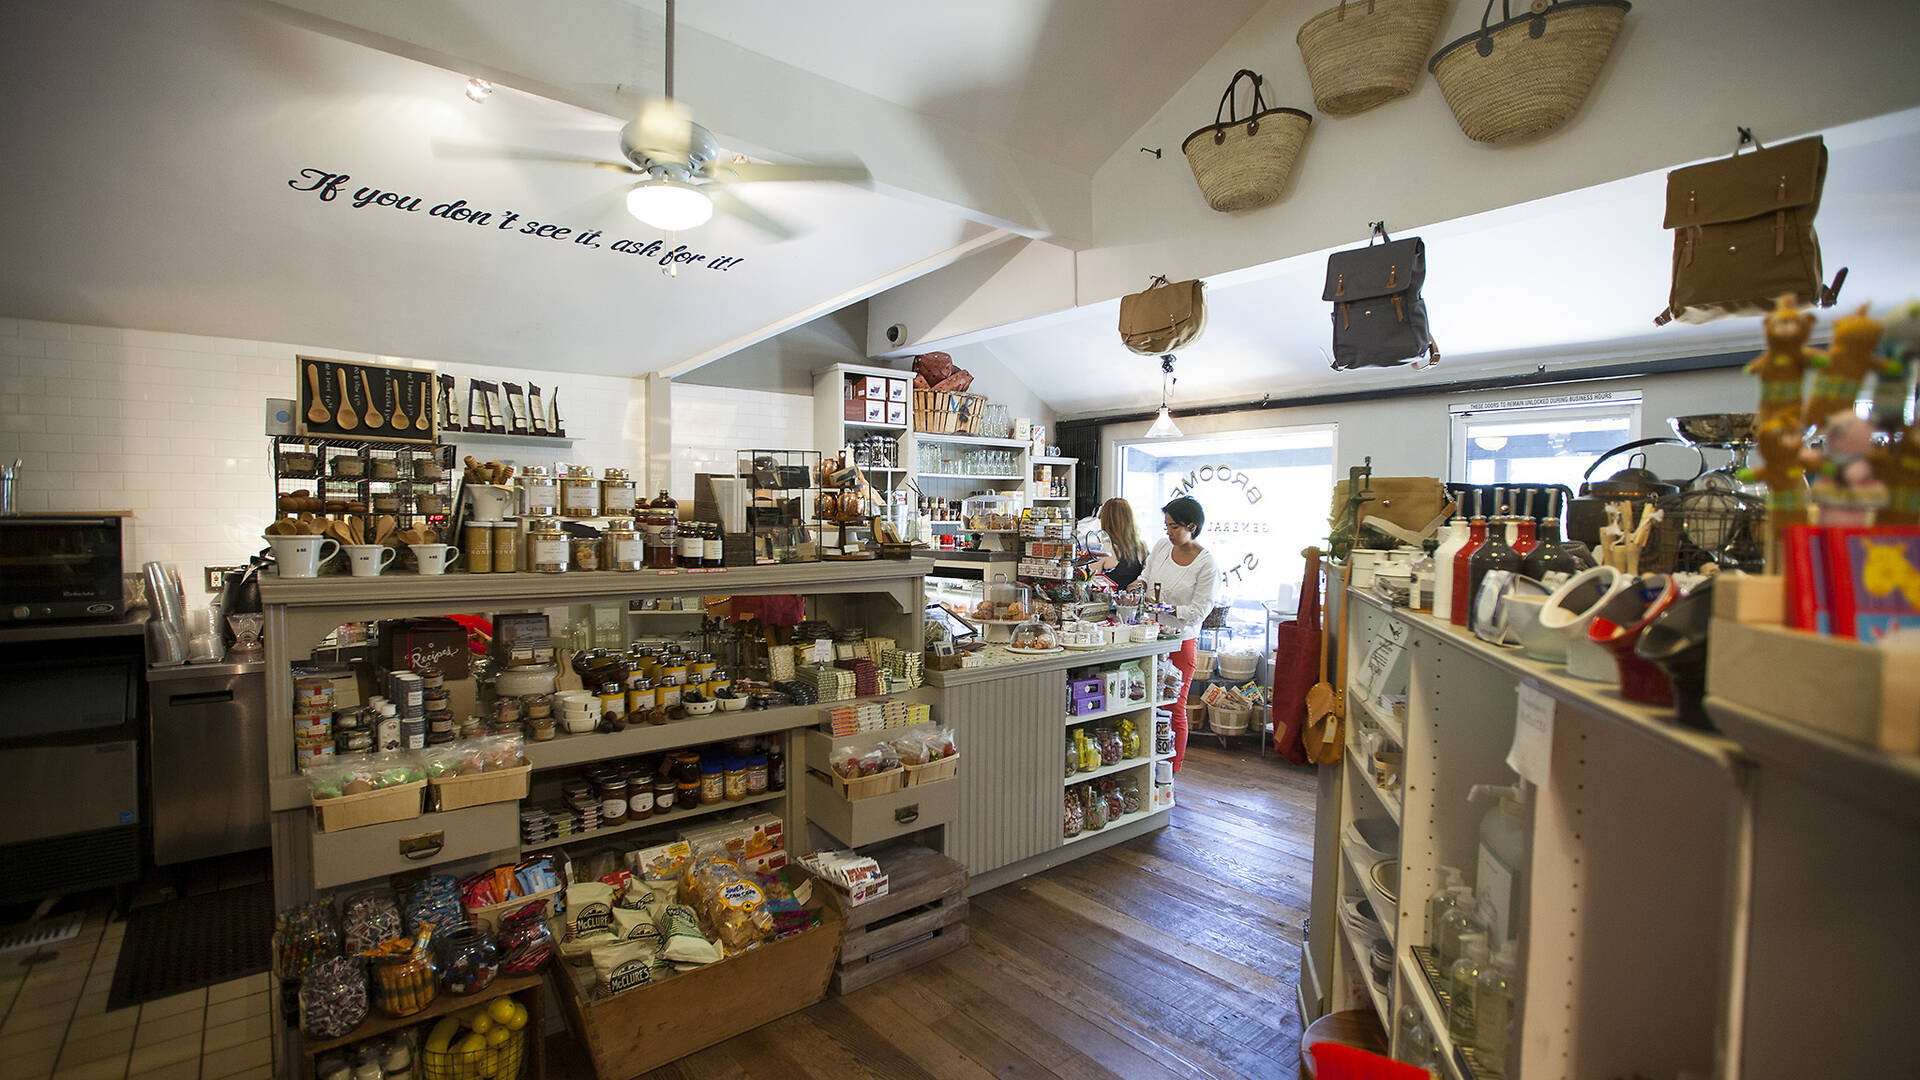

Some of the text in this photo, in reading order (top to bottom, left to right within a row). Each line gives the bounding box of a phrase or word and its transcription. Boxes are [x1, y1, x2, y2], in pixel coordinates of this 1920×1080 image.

[288, 168, 744, 272] If you don't see it, ask for it!
[1525, 398, 1549, 406] UNLOCKED
[1569, 394, 1593, 402] BUSINESS
[1594, 392, 1612, 400] HOURS
[411, 645, 459, 668] Recipes
[577, 915, 608, 930] McCLURE
